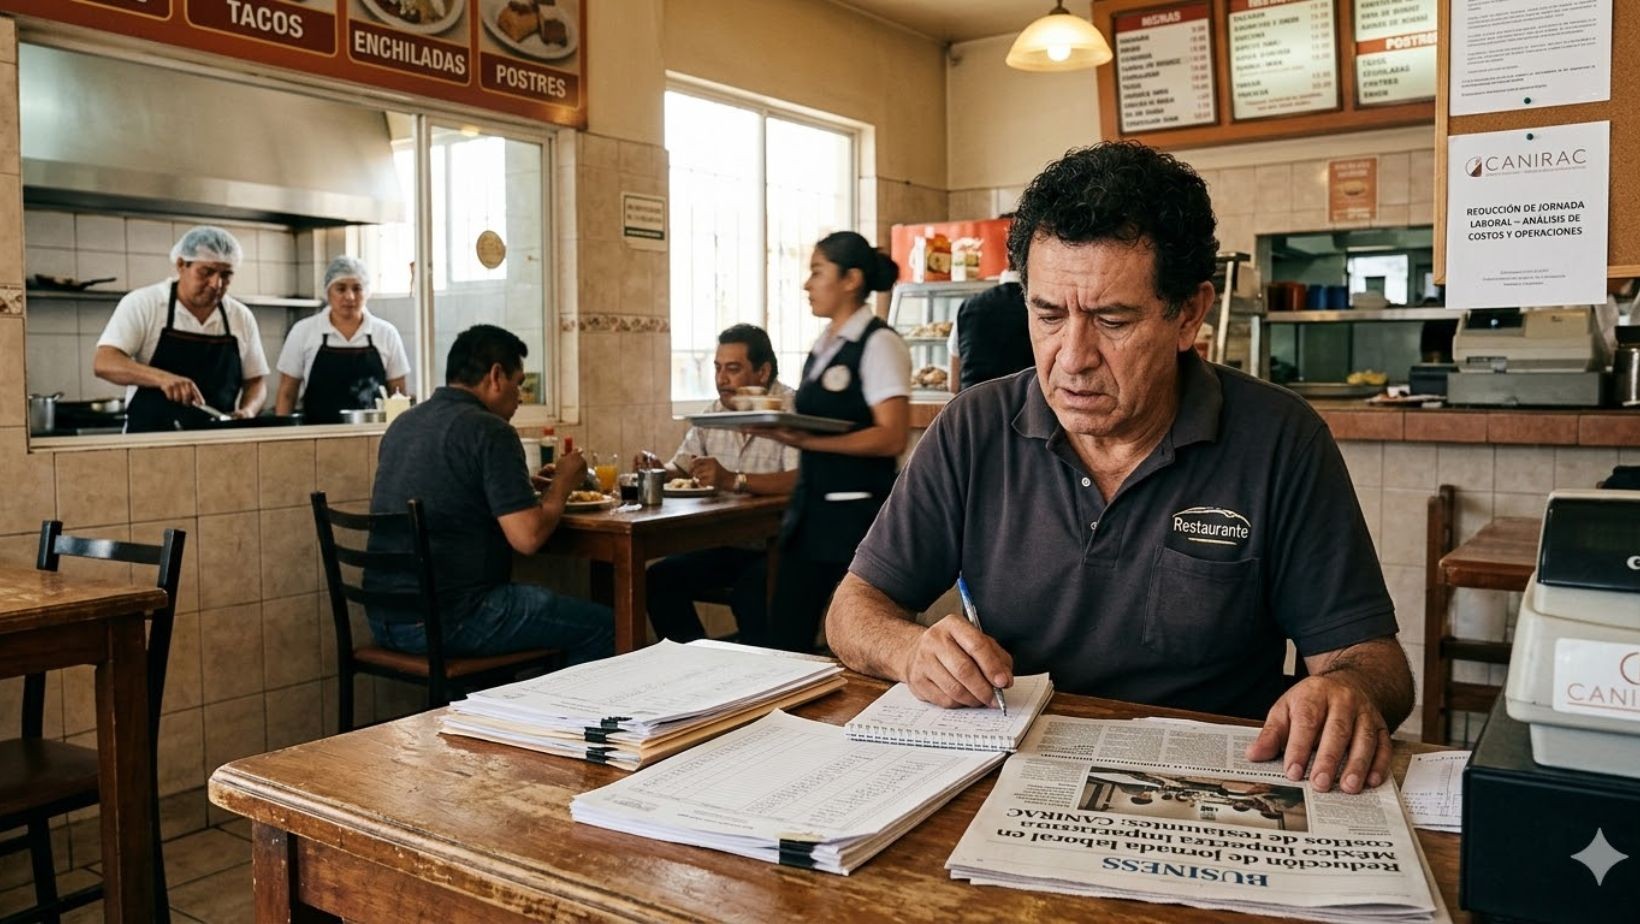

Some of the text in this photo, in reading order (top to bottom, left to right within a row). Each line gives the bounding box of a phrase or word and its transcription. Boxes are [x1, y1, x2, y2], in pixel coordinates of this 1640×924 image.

[227, 0, 304, 39] TACOS
[354, 30, 466, 76] ENCHILADAS
[496, 64, 567, 98] POSTRES
[1485, 148, 1587, 172] CANIRAC
[1524, 204, 1536, 213] DE
[1538, 201, 1585, 213] JORNADA
[1470, 217, 1512, 229] LABORAL
[1568, 214, 1581, 223] DE
[1468, 226, 1583, 241] COSTOS Y OPERACIONES
[1173, 517, 1249, 538] Restaurante
[1006, 808, 1114, 826] CANIRAC
[997, 828, 1025, 839] en
[1031, 832, 1118, 850] laboral
[1269, 834, 1298, 845] de
[1228, 852, 1259, 864] de
[1266, 857, 1402, 872] Reducción
[1103, 857, 1269, 887] BUSINESS
